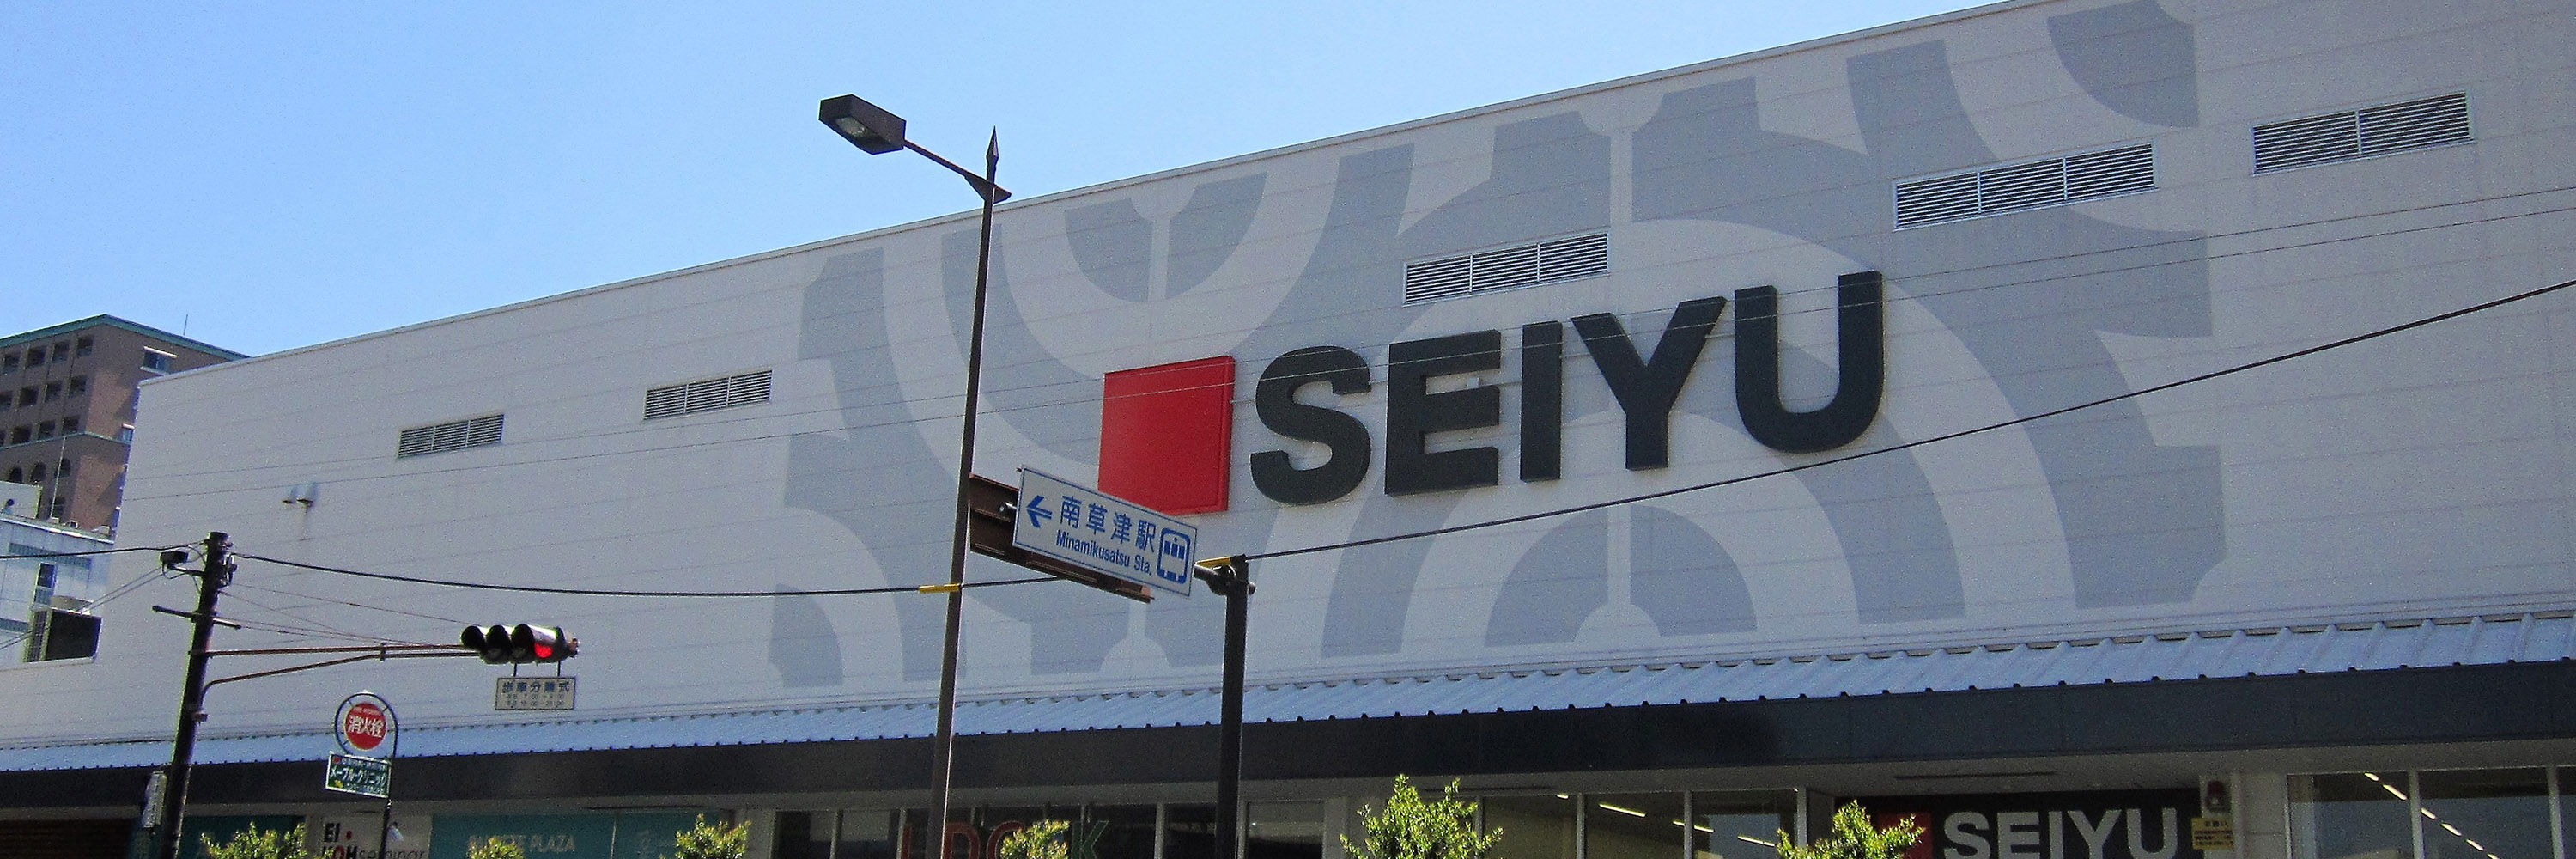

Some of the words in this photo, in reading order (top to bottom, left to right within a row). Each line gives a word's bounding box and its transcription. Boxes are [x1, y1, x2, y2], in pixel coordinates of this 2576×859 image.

[1250, 271, 1884, 505] SEIYU
[1060, 495, 1157, 553] 南草津駅
[1055, 529, 1130, 568] Minamikusatsu
[1133, 554, 1152, 576] Sta.
[348, 715, 385, 738] 消火栓
[529, 834, 575, 853] PLAZA
[1943, 807, 2177, 859] SEIYU
